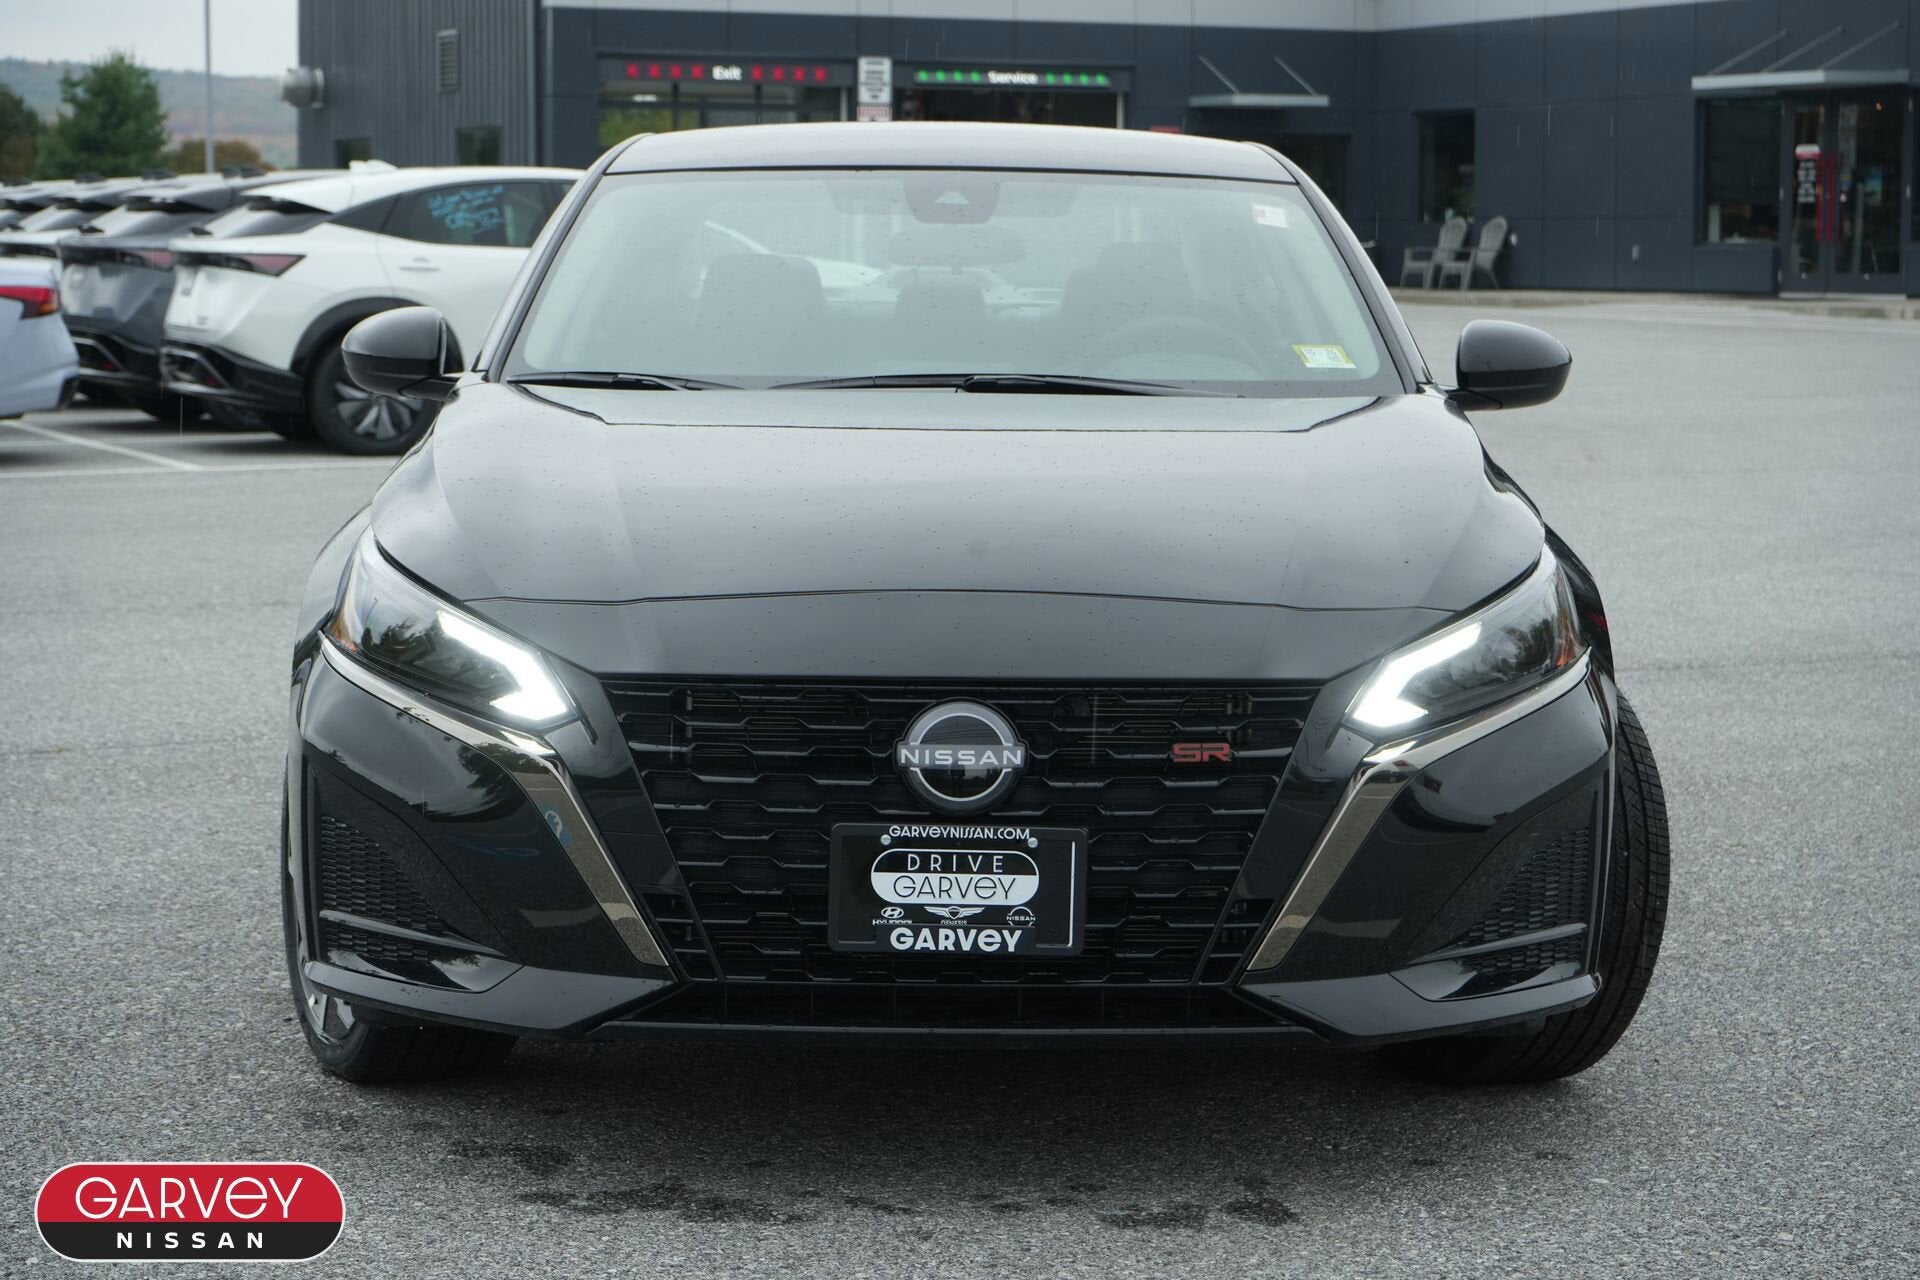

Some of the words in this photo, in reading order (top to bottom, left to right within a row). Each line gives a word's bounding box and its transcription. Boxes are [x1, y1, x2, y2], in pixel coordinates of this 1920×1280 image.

[712, 65, 742, 80] Exit
[988, 70, 1038, 84] Service
[901, 749, 1021, 765] NISSAN
[1173, 743, 1230, 762] SR
[889, 825, 1030, 840] GARVEYNISSAN.COM
[907, 854, 1004, 873] DRIVE
[893, 876, 1016, 900] GARVEY
[890, 927, 1022, 952] GARVEY
